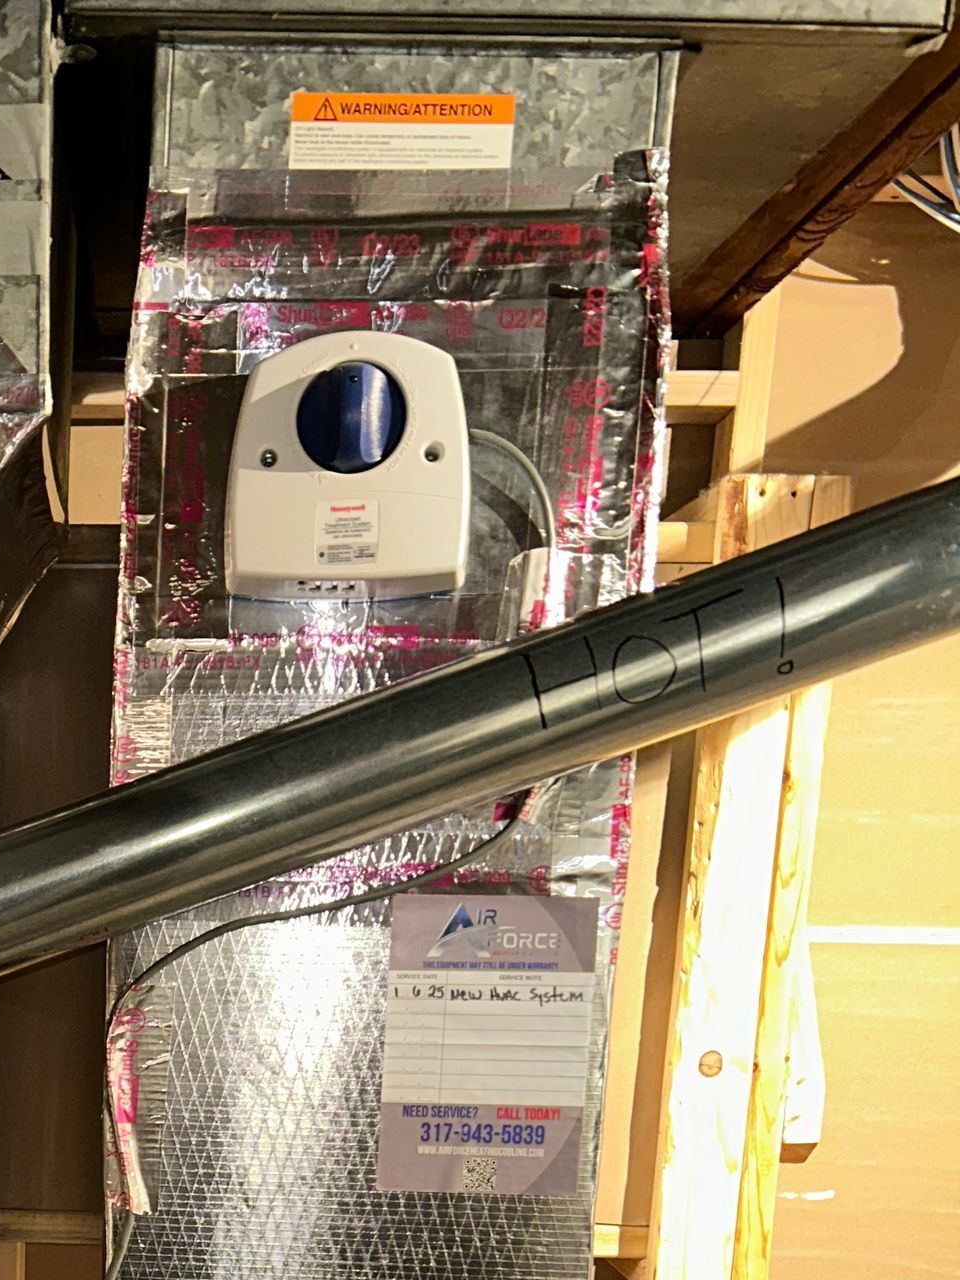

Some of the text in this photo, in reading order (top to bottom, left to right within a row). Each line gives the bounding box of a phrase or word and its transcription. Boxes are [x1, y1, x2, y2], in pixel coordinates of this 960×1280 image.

[339, 103, 493, 117] WARNING/ATTENTION
[498, 308, 547, 330] Q2/2
[428, 986, 445, 999] 25
[402, 1105, 561, 1121] NEED SERVICE? CALL TODAY!
[420, 1121, 545, 1145] 317-943-5839
